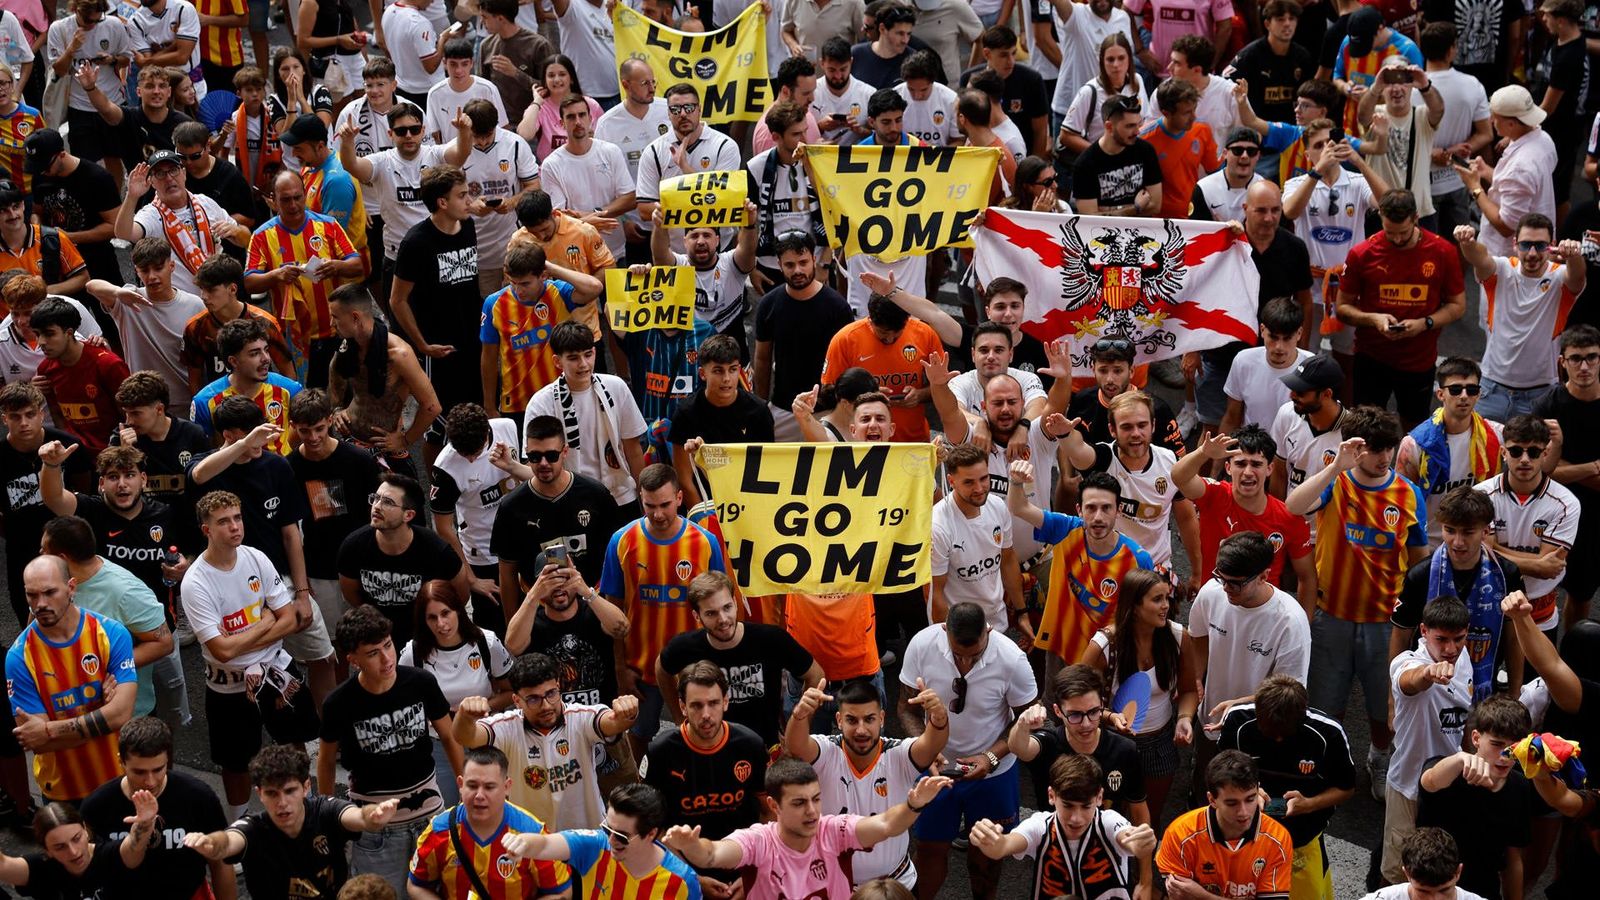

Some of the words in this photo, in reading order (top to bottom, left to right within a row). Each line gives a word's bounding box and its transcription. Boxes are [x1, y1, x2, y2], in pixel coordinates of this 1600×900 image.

[646, 18, 739, 54] LIM
[155, 151, 169, 159] VCF
[836, 146, 957, 174] LIM
[483, 179, 509, 188] TERRA
[677, 172, 729, 191] LIM
[399, 190, 414, 200] TM
[864, 178, 926, 208] GO
[946, 183, 971, 200] 19'
[775, 203, 789, 211] TM
[664, 207, 745, 225] HOME
[1318, 228, 1345, 241] Ford
[624, 268, 677, 292] LIM
[1383, 288, 1399, 297] TM
[614, 304, 690, 327] HOME
[514, 336, 530, 347] TM
[649, 378, 664, 388] TM
[740, 445, 891, 497] LIM
[990, 479, 1008, 491] TM
[483, 489, 500, 501] TM
[717, 503, 745, 523] 19'
[774, 502, 851, 537] GO
[877, 507, 909, 526] 19'
[1348, 527, 1364, 541] TM
[106, 544, 165, 561] TOYOTA
[642, 588, 659, 599] TM
[226, 615, 243, 629] TM
[56, 694, 75, 707] TM
[564, 690, 600, 706] 238
[1442, 713, 1457, 724] TM
[681, 790, 744, 809] CAZOO
[162, 828, 185, 849] 19
